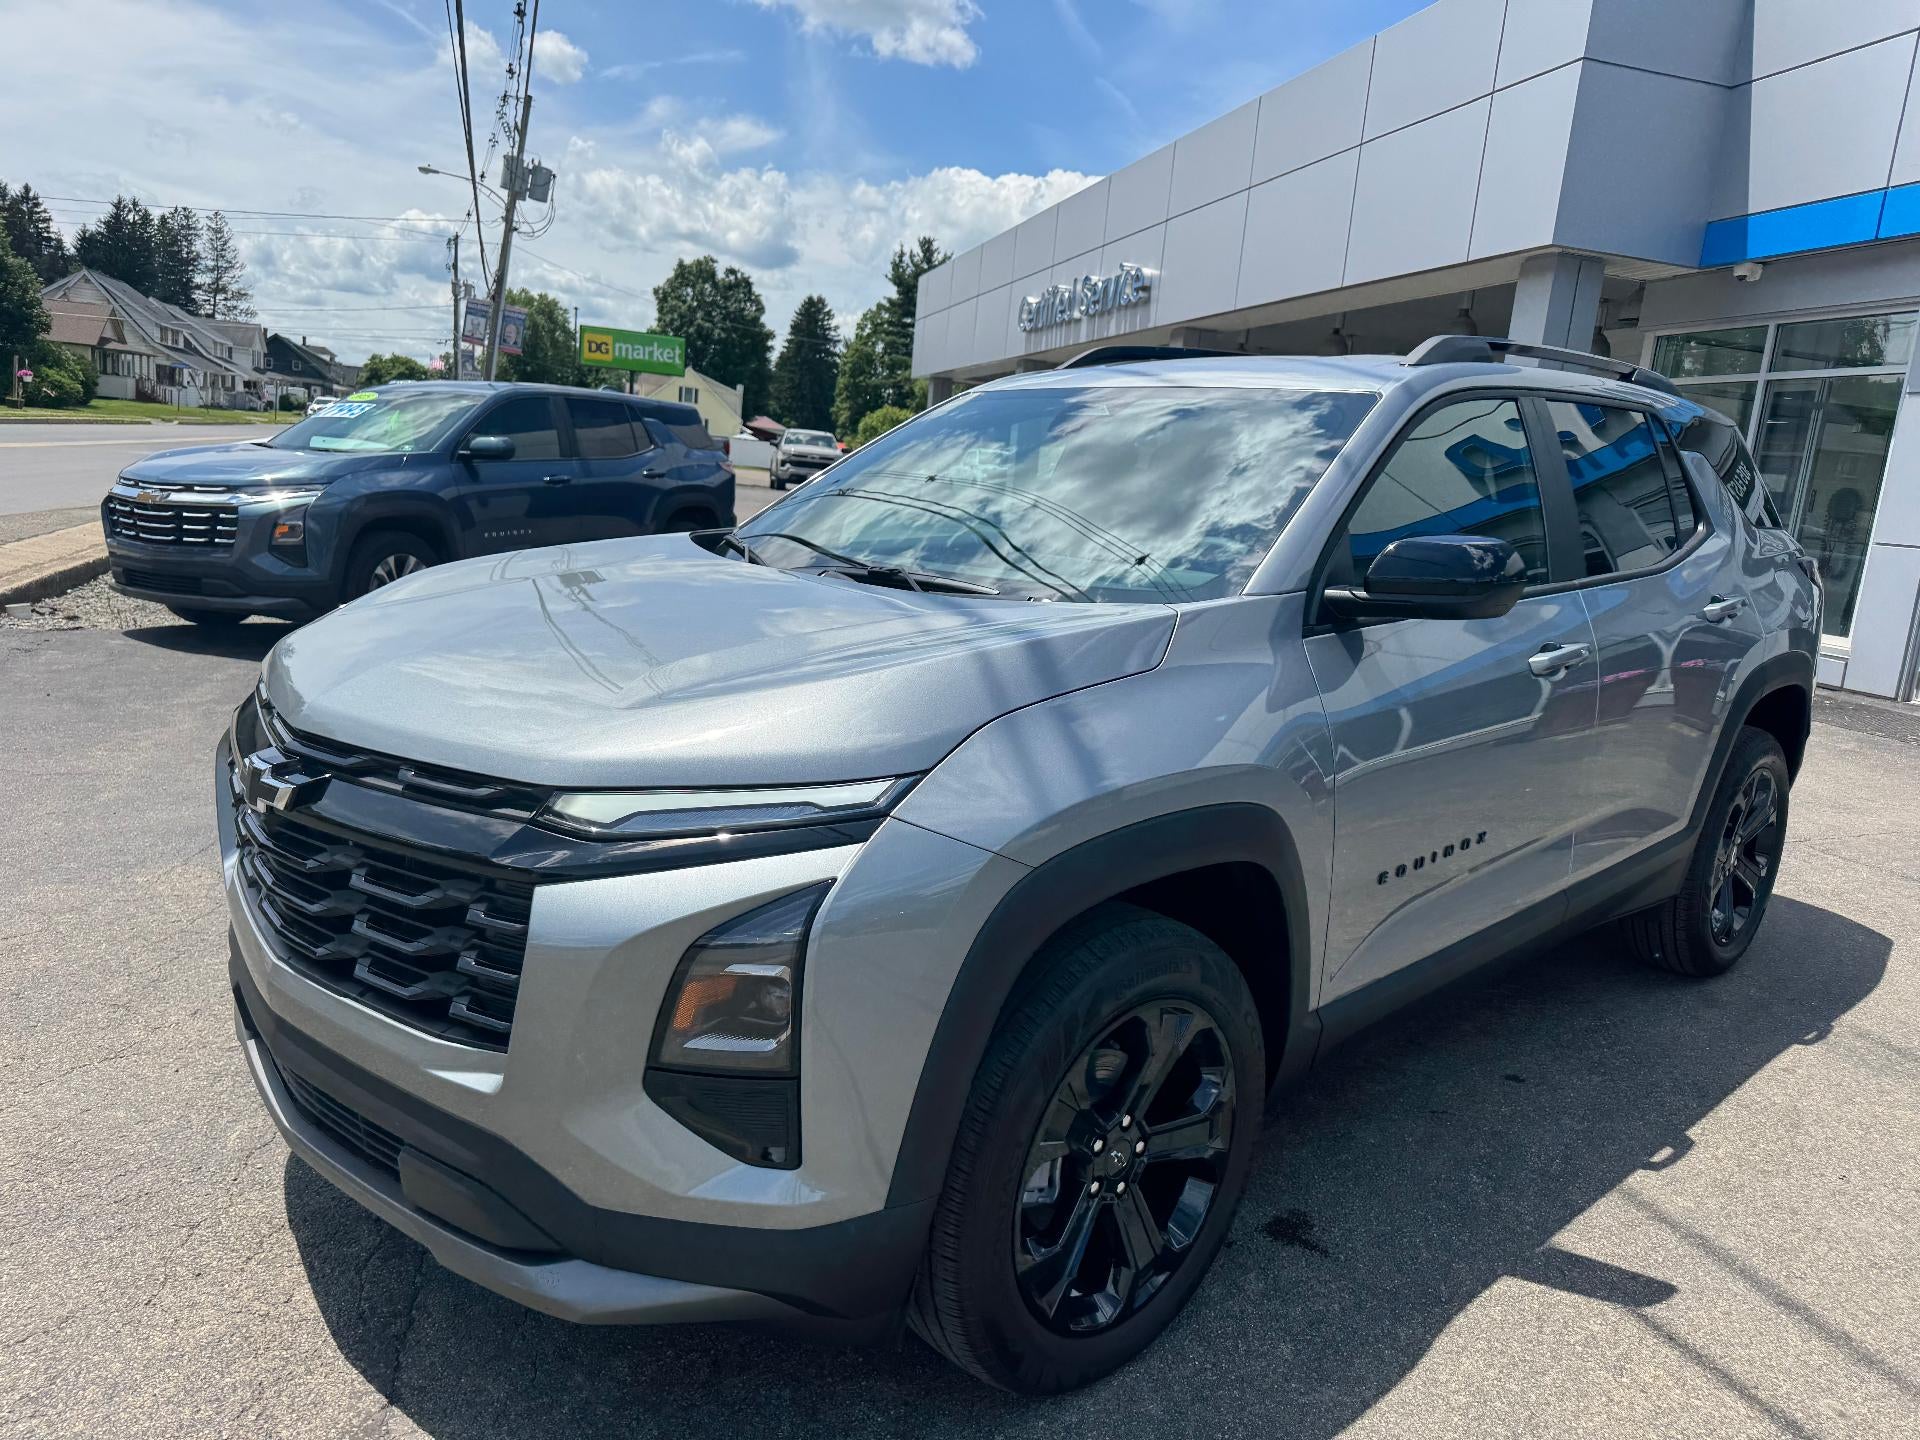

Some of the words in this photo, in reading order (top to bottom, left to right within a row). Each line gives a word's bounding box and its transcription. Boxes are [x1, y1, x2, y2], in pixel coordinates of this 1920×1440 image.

[1018, 277, 1081, 332] Certified
[1080, 262, 1150, 317] Service
[587, 339, 610, 355] DG
[614, 341, 681, 364] market
[1376, 831, 1487, 885] EQUINOX
